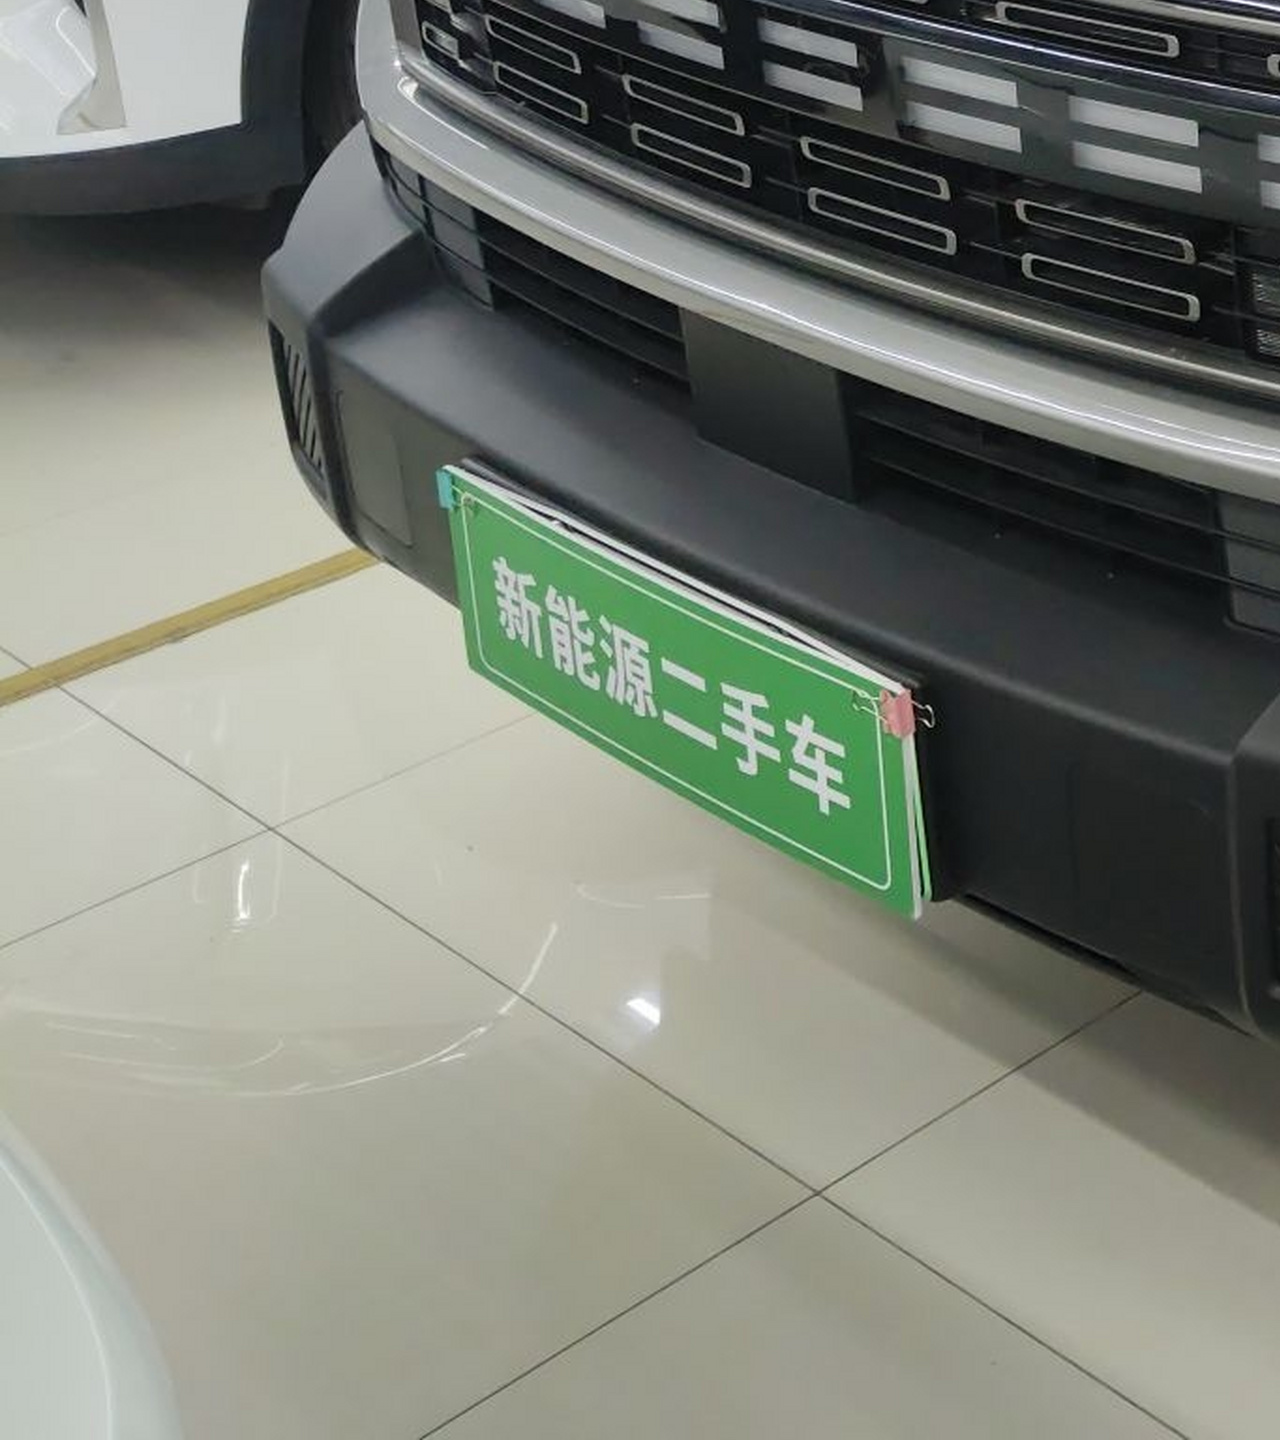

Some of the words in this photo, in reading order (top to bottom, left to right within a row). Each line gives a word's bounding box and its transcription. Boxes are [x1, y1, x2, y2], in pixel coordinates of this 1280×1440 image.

[492, 555, 851, 816] 新能源二手车
